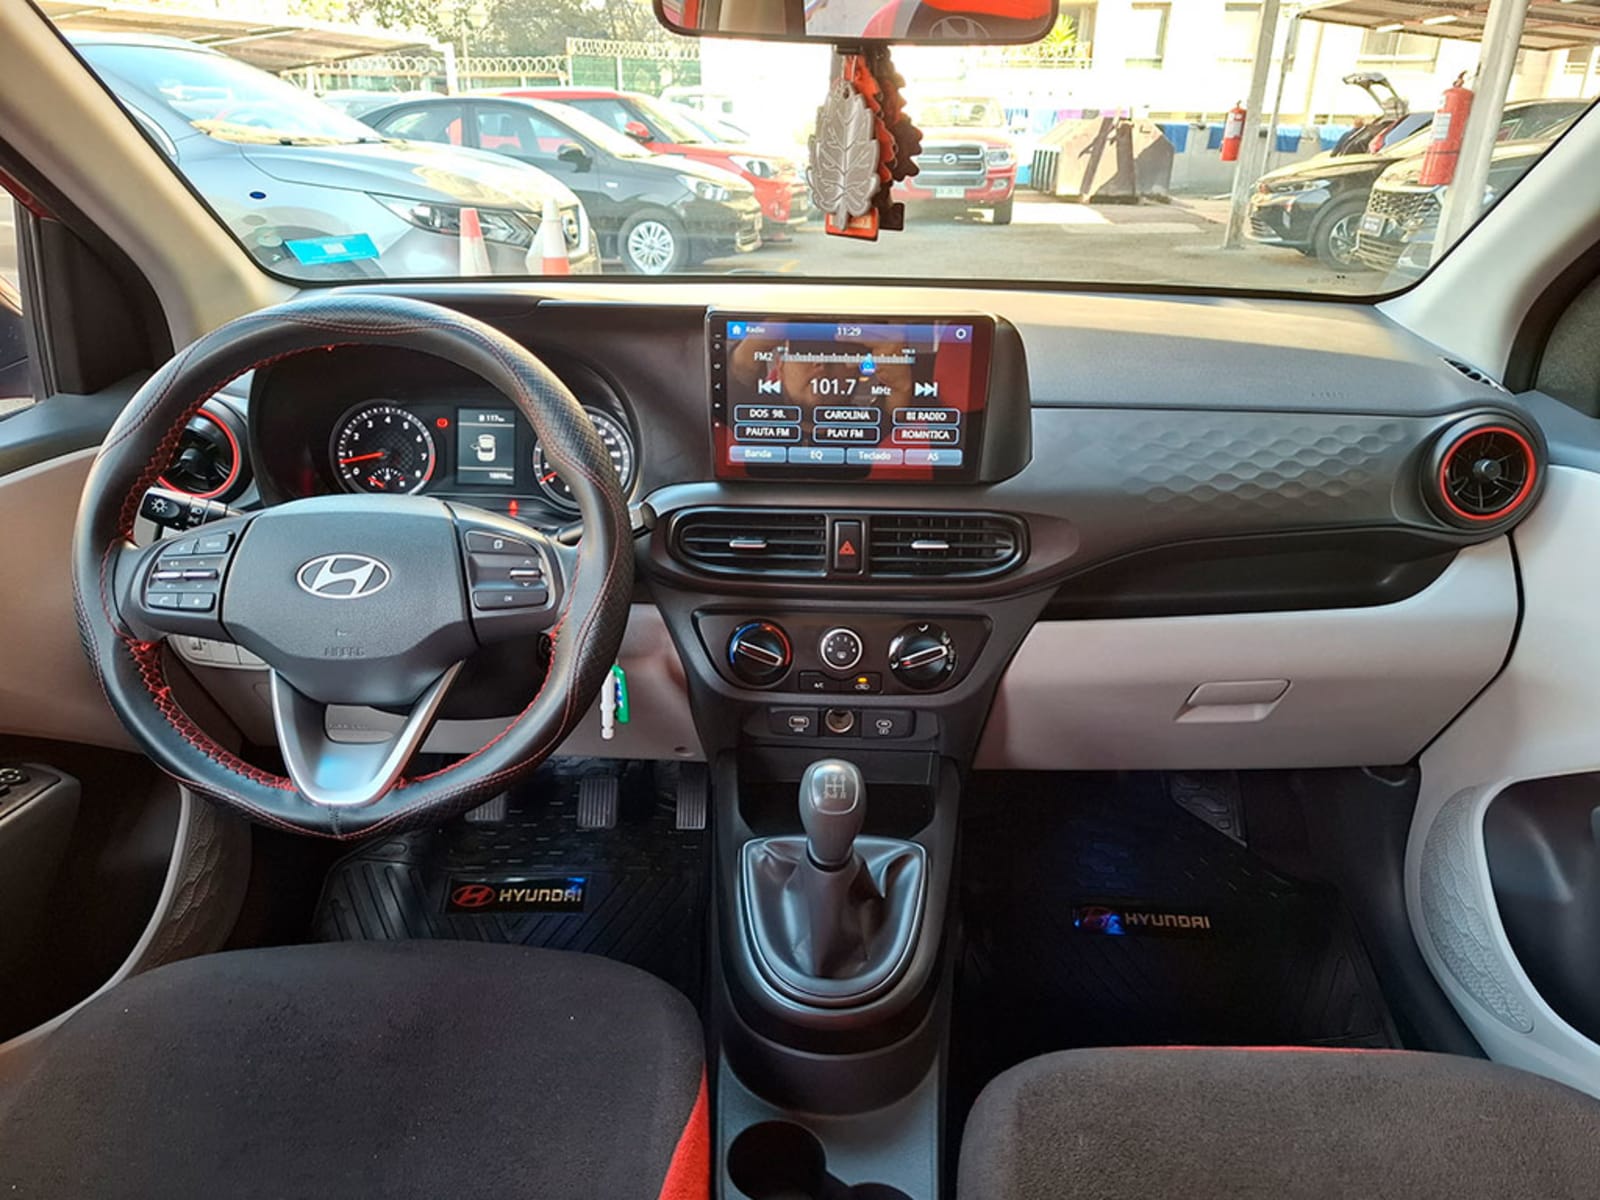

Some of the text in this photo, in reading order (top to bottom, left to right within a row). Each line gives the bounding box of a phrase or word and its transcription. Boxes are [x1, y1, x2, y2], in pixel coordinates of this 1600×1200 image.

[837, 327, 861, 337] 11:29
[754, 352, 773, 361] FM2
[810, 378, 856, 395] 101.7
[749, 408, 769, 419] DOS
[824, 410, 870, 420] CAROLINA
[918, 412, 947, 421] RADIO
[745, 427, 790, 437] PAUTA FM
[827, 429, 864, 439] PLAY FM
[810, 450, 824, 460] EQ
[499, 888, 582, 902] HYUNDAI
[1124, 912, 1211, 928] HYUNDAI
